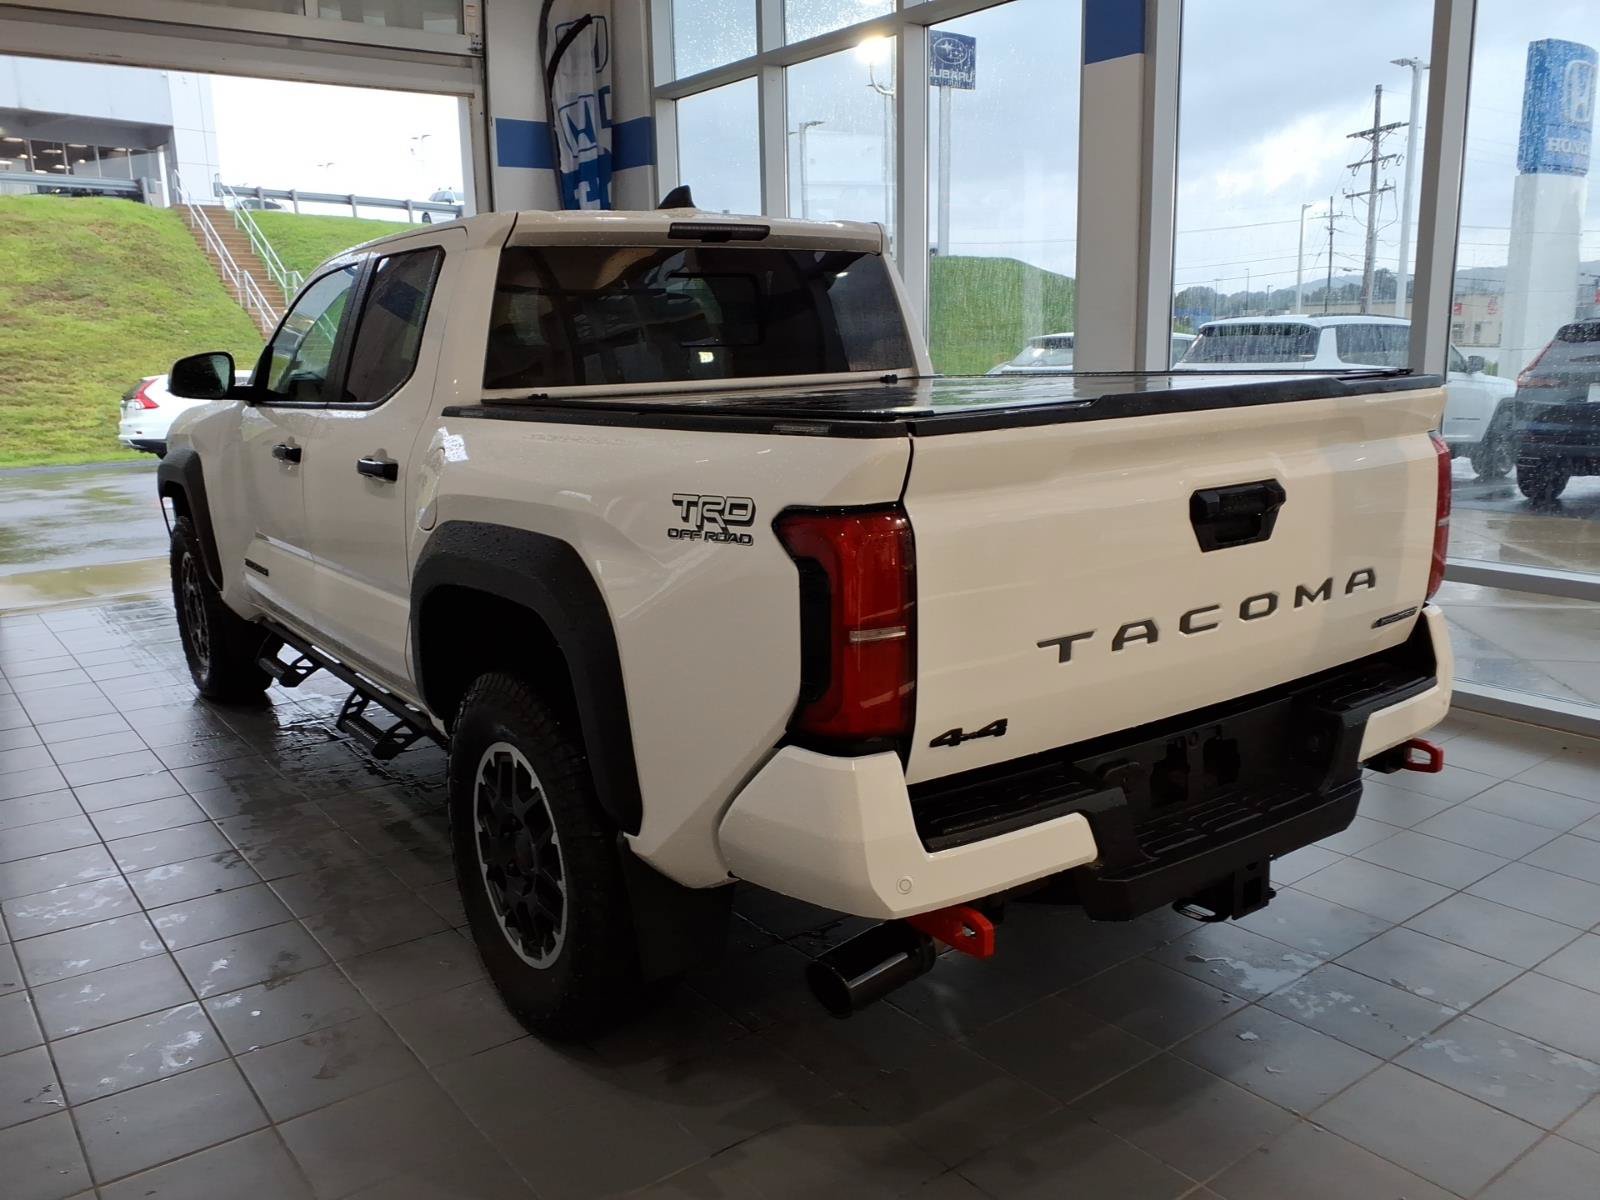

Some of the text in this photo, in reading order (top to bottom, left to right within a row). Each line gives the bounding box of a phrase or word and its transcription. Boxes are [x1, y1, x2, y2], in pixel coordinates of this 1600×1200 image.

[672, 493, 756, 530] TRD
[667, 528, 753, 546] OFF ROAD
[1036, 567, 1377, 664] TACOMA
